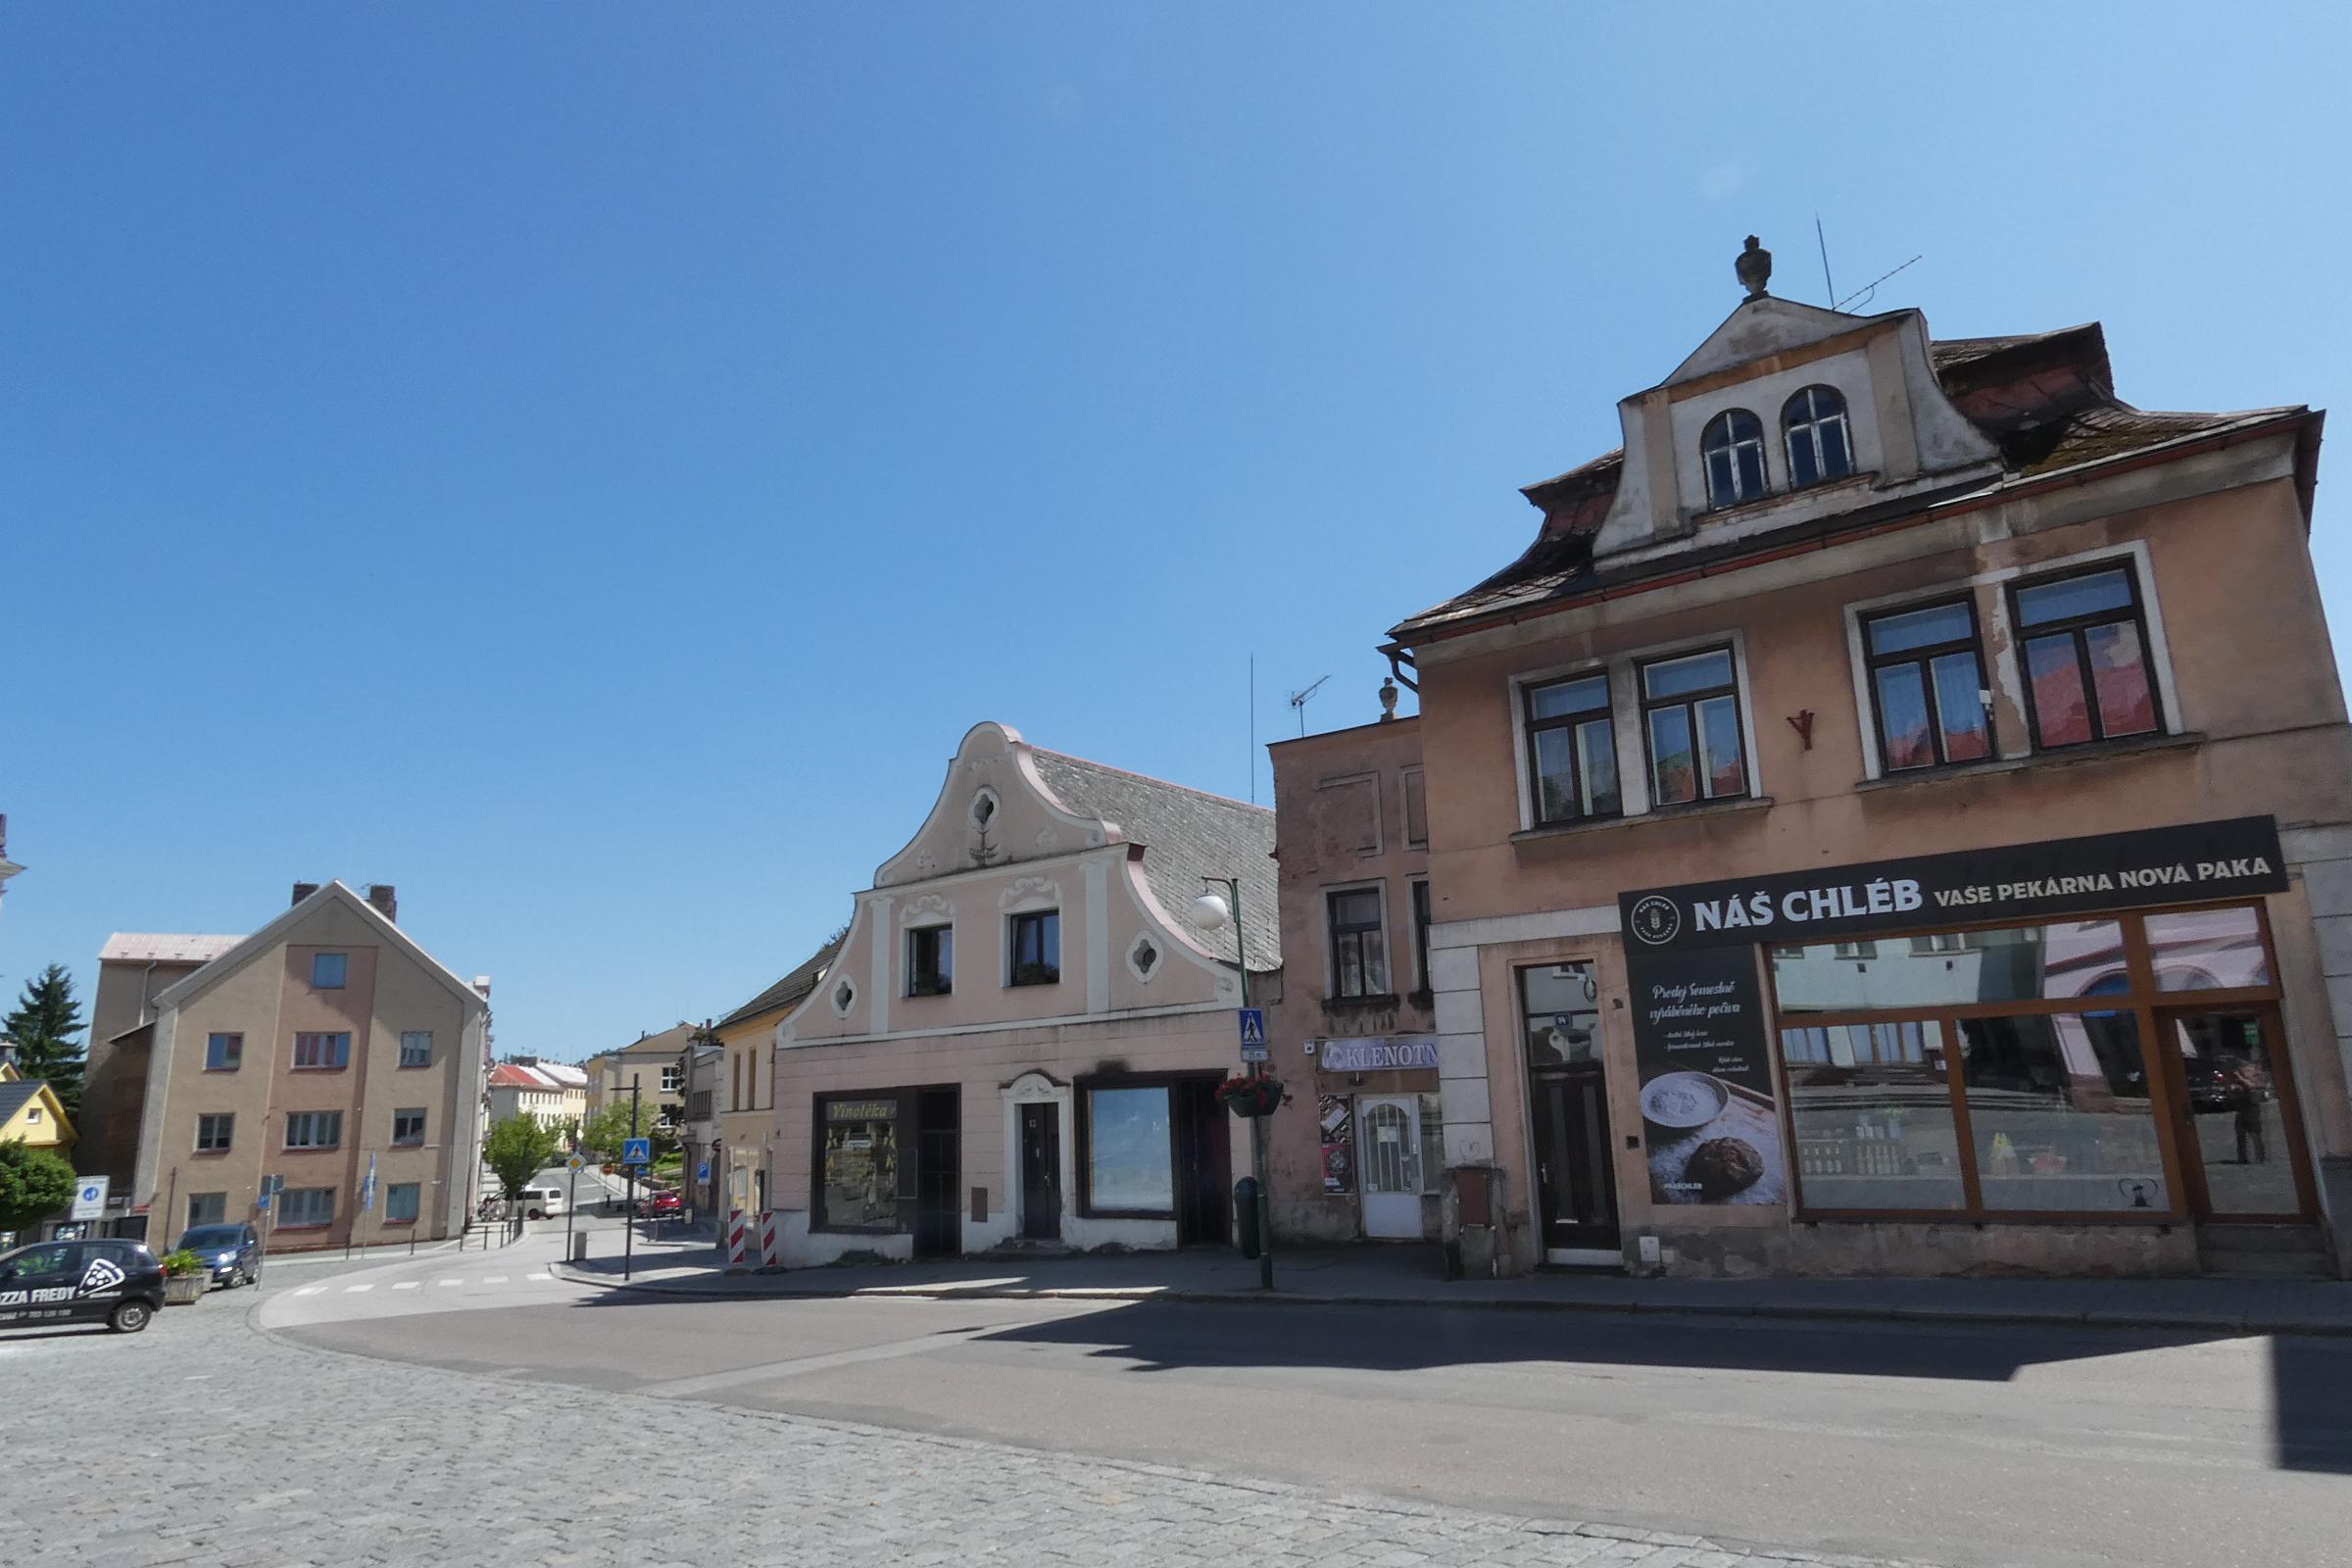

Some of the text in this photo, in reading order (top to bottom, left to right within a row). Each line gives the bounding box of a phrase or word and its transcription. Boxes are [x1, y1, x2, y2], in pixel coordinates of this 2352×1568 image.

[1693, 857, 2272, 932] NÁŠ CHLÉB VAŠE PEKÁRNA NOVÁ PAKA
[1652, 984, 1687, 1004] Prodej
[0, 1291, 27, 1306] ZZA
[31, 1286, 77, 1303] FREDY
